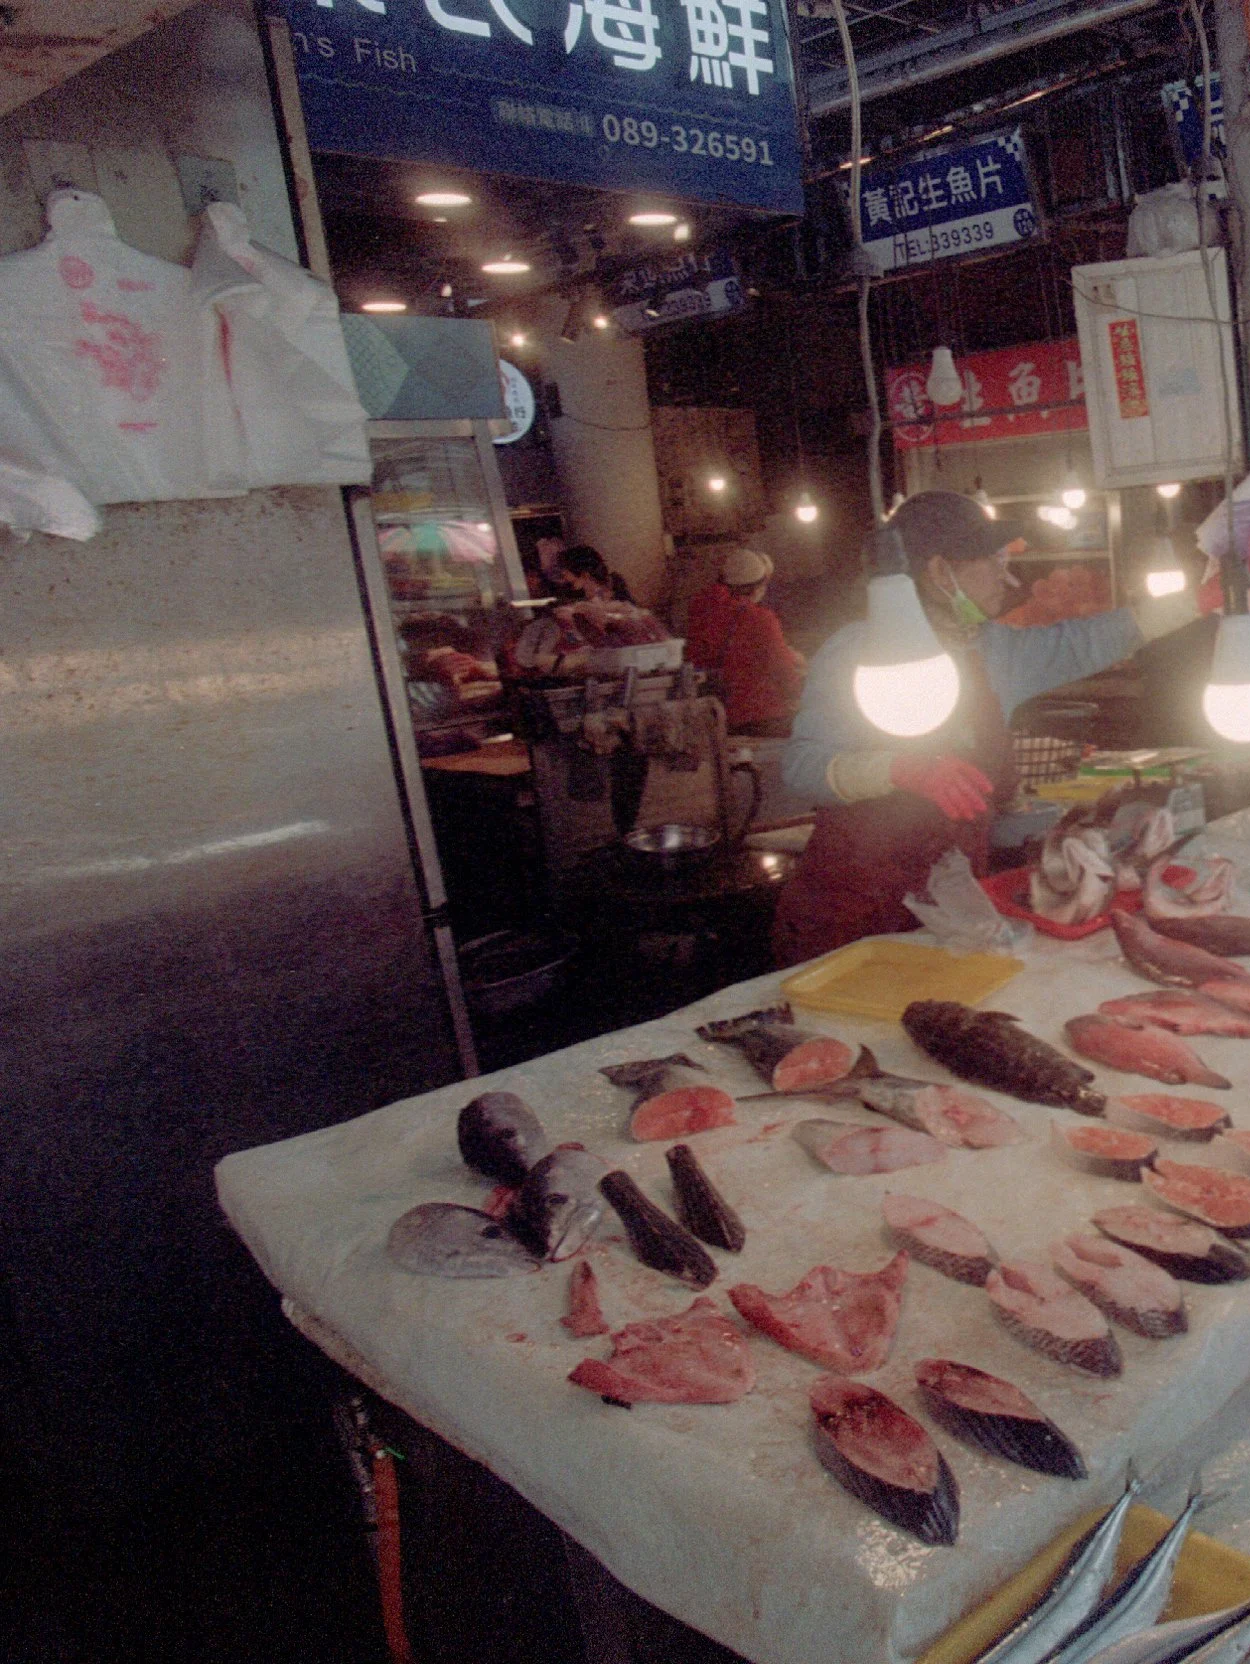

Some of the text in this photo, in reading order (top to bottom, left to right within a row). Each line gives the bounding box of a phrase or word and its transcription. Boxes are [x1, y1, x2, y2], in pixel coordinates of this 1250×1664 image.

[353, 37, 417, 73] Fish
[602, 113, 773, 165] 089-326591
[862, 154, 1004, 227] 黃記生魚片
